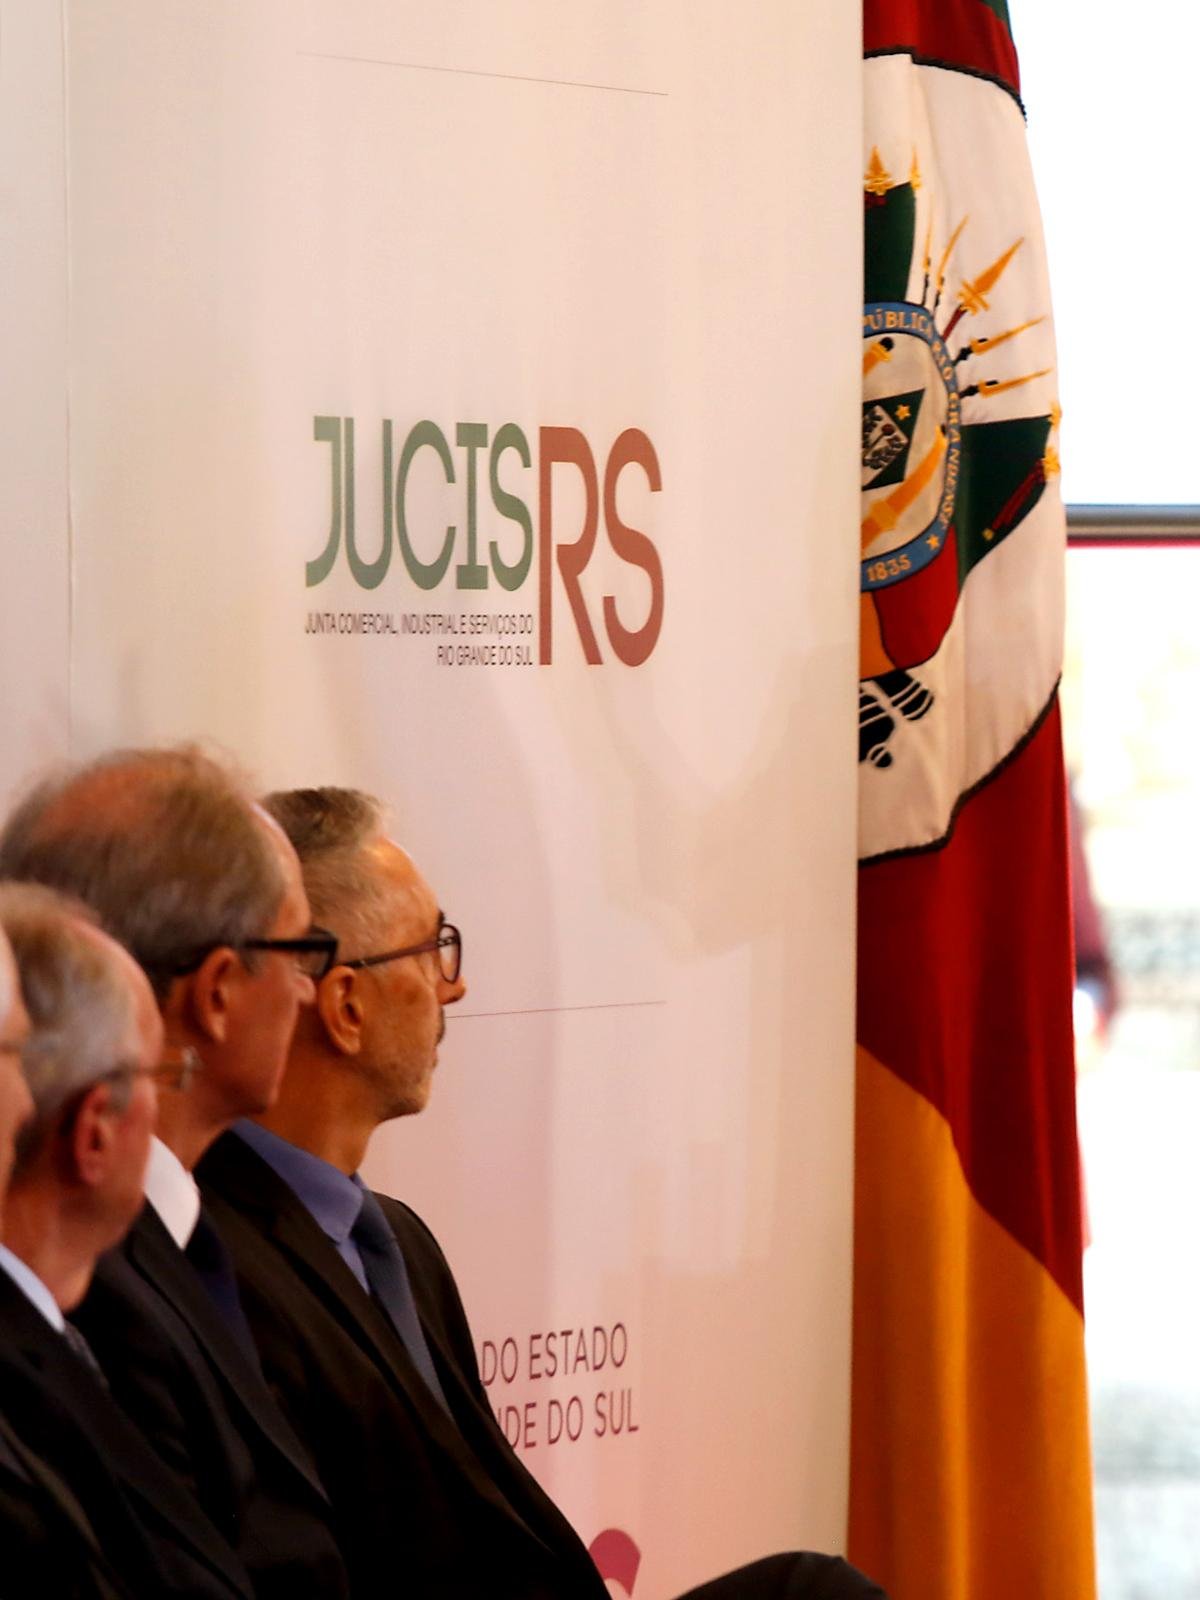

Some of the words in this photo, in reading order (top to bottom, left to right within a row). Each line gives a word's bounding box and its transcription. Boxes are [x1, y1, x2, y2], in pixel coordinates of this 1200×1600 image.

[867, 554, 911, 582] 1835
[305, 613, 337, 634] JUNTA
[402, 614, 458, 634] INDUSTRIAL
[469, 614, 516, 639] SERVIÇOS
[519, 614, 533, 634] DO
[437, 645, 454, 665] RIO
[456, 645, 496, 665] GRANDE
[499, 645, 513, 665] DO
[515, 645, 533, 665] SUL
[482, 1338, 518, 1386] DO
[530, 1322, 628, 1380] ESTADO
[548, 1395, 584, 1445] DO
[595, 1388, 639, 1438] SUL
